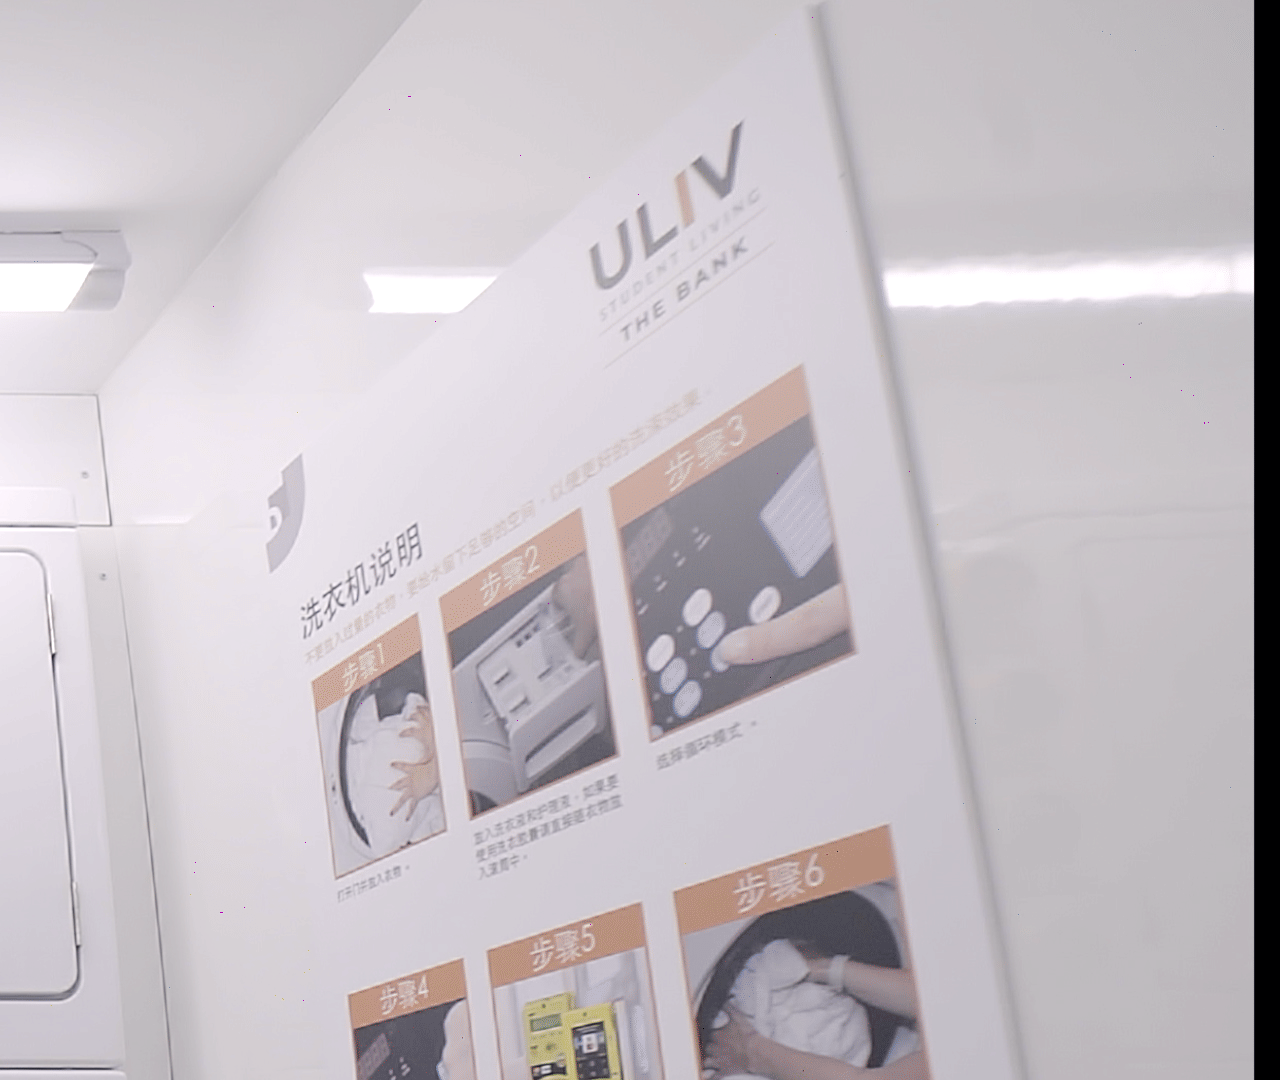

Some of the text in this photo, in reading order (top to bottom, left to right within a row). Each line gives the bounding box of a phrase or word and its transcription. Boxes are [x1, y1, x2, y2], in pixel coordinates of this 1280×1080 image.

[589, 118, 746, 290] ULIV
[620, 237, 748, 342] THE BANK
[301, 522, 423, 639] 洗衣机说明
[733, 854, 826, 914] 步骤6
[529, 924, 596, 972] 步骤5
[380, 975, 430, 1016] 步骤4
